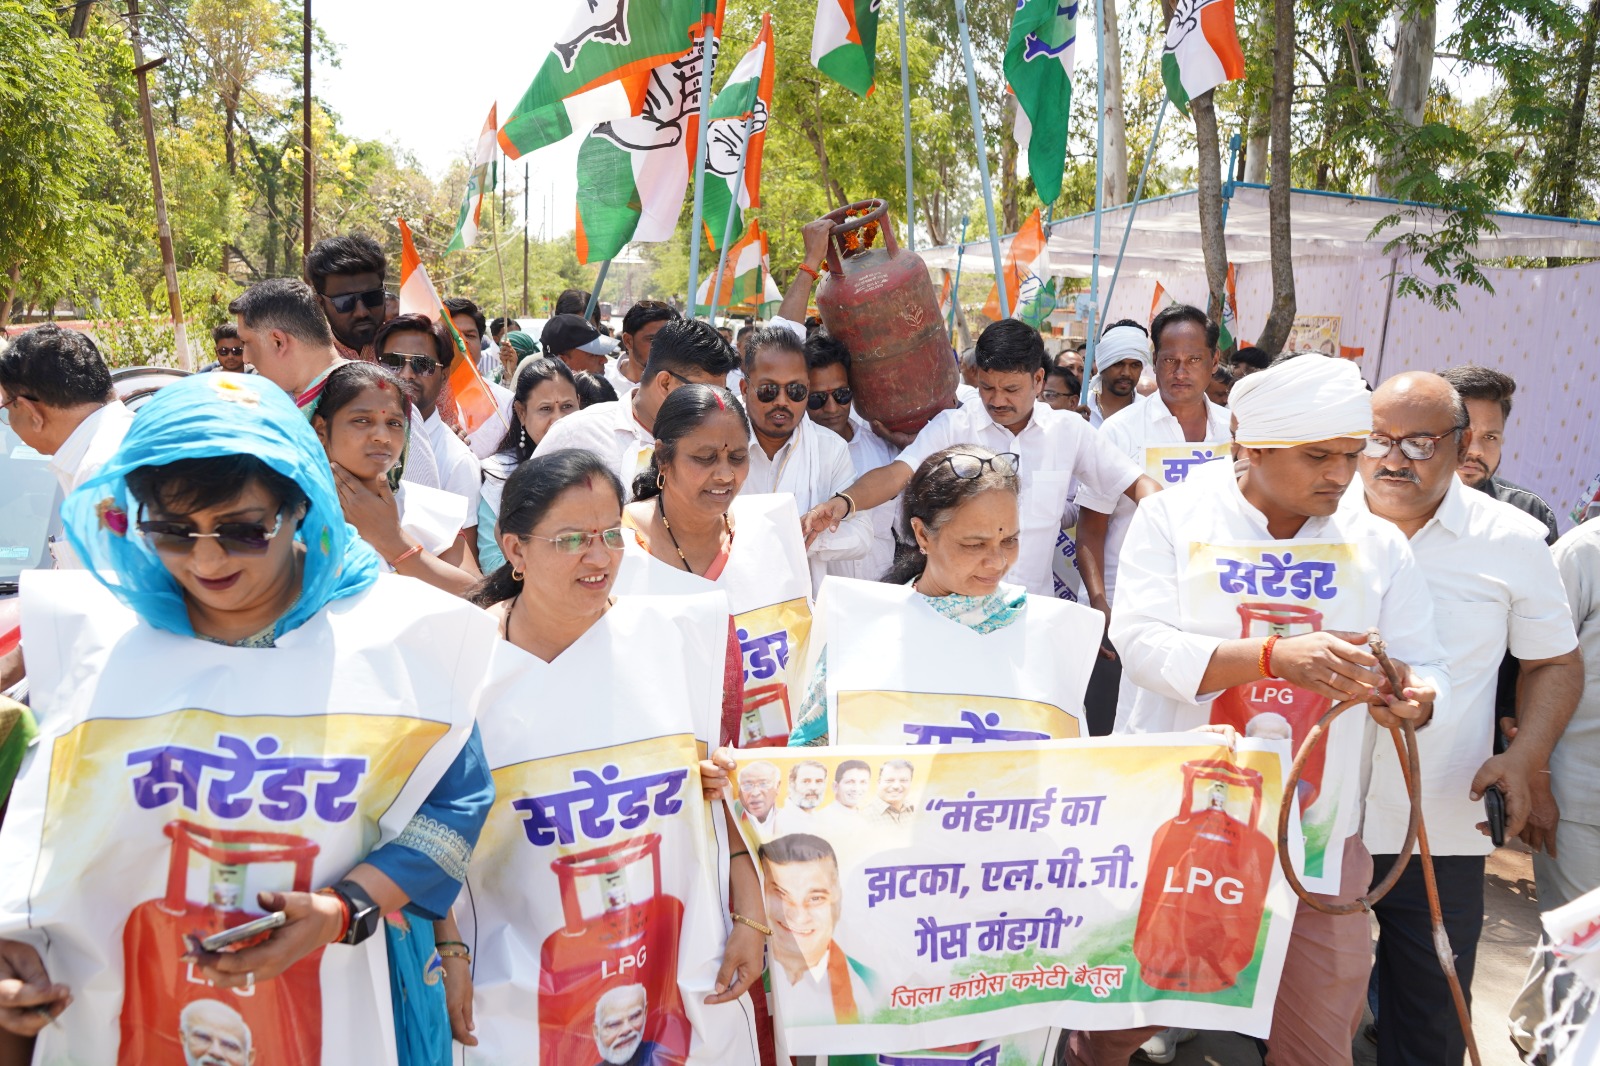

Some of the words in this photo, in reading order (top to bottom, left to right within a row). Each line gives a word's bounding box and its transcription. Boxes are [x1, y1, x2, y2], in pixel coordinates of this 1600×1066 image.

[1216, 552, 1338, 600] सरेंडर
[1250, 686, 1294, 705] LPG
[126, 734, 367, 823] सरेंडर
[512, 764, 688, 847] सरेंडर
[1060, 795, 1107, 827] का
[864, 863, 971, 908] झटका,
[1162, 866, 1245, 905] LPG
[914, 916, 971, 963] गैस
[186, 962, 255, 997] LG
[601, 945, 647, 980] LPG
[891, 985, 945, 1008] जिला
[949, 972, 1008, 1000] कांग्रेस
[1011, 964, 1070, 990] कमेटी
[1074, 964, 1125, 996] बैतूल
